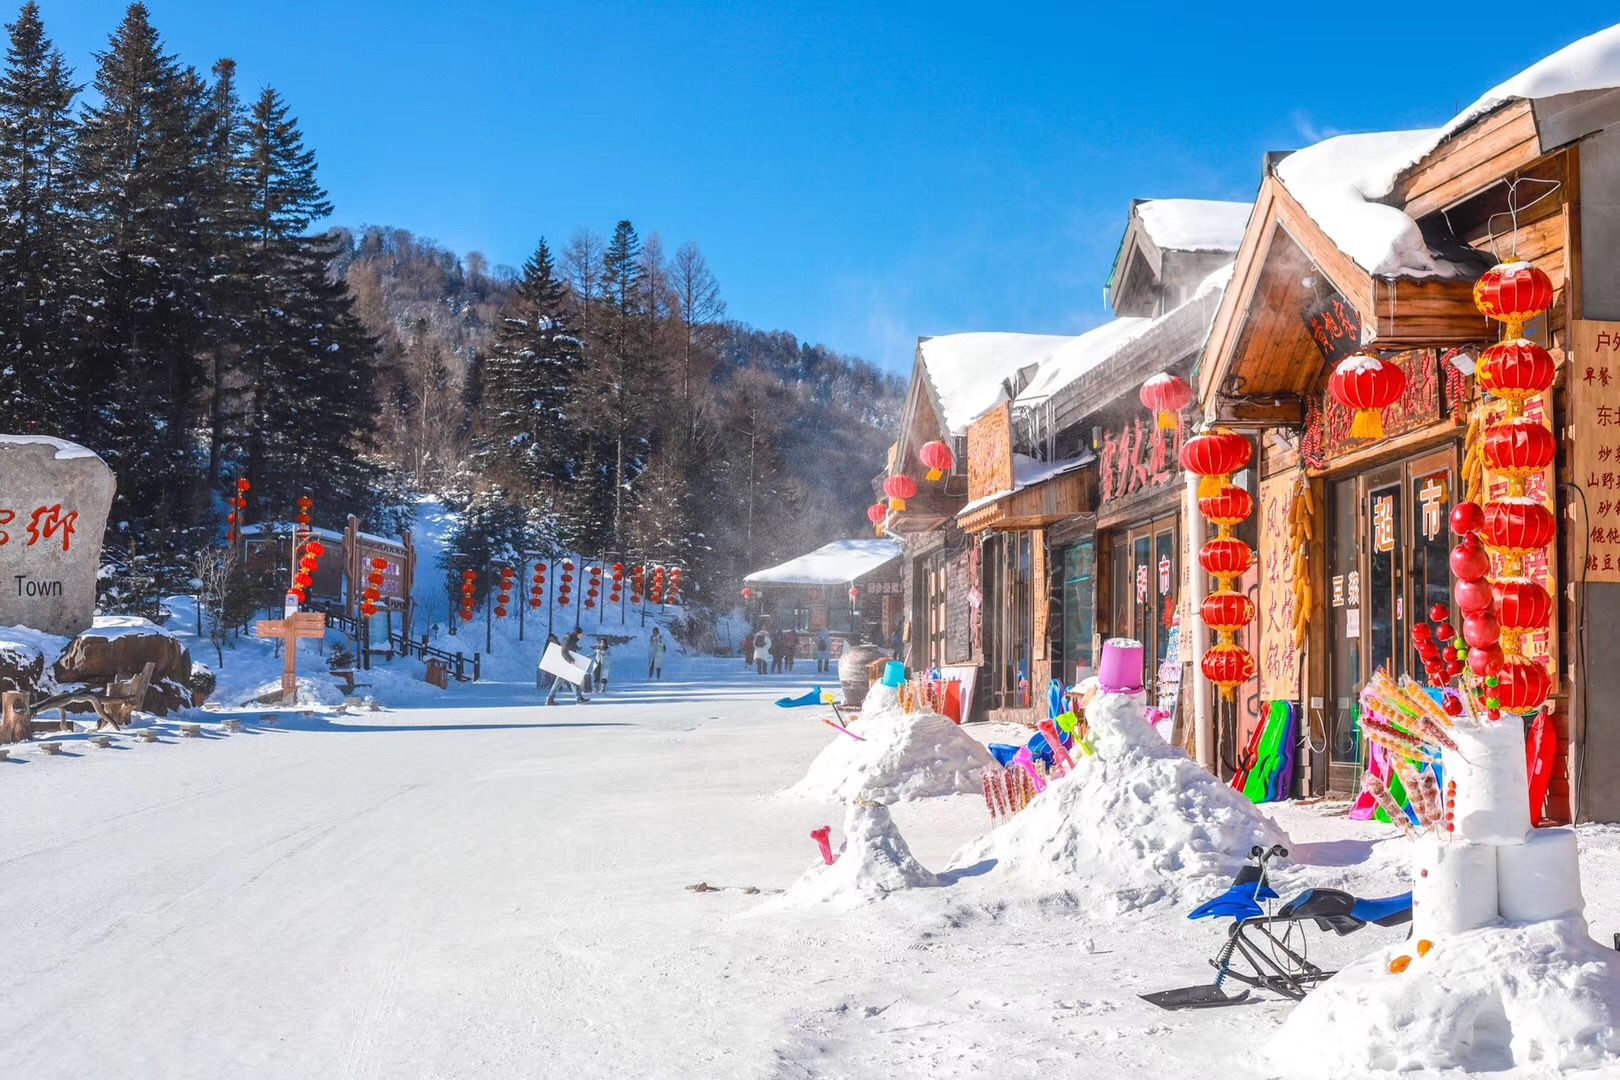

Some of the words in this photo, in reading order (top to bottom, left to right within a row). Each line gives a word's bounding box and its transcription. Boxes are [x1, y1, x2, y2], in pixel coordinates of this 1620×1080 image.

[1583, 367, 1612, 387] 早餐
[1373, 478, 1442, 554] 超市
[1585, 554, 1620, 571] 粘豆
[15, 575, 62, 597] Town
